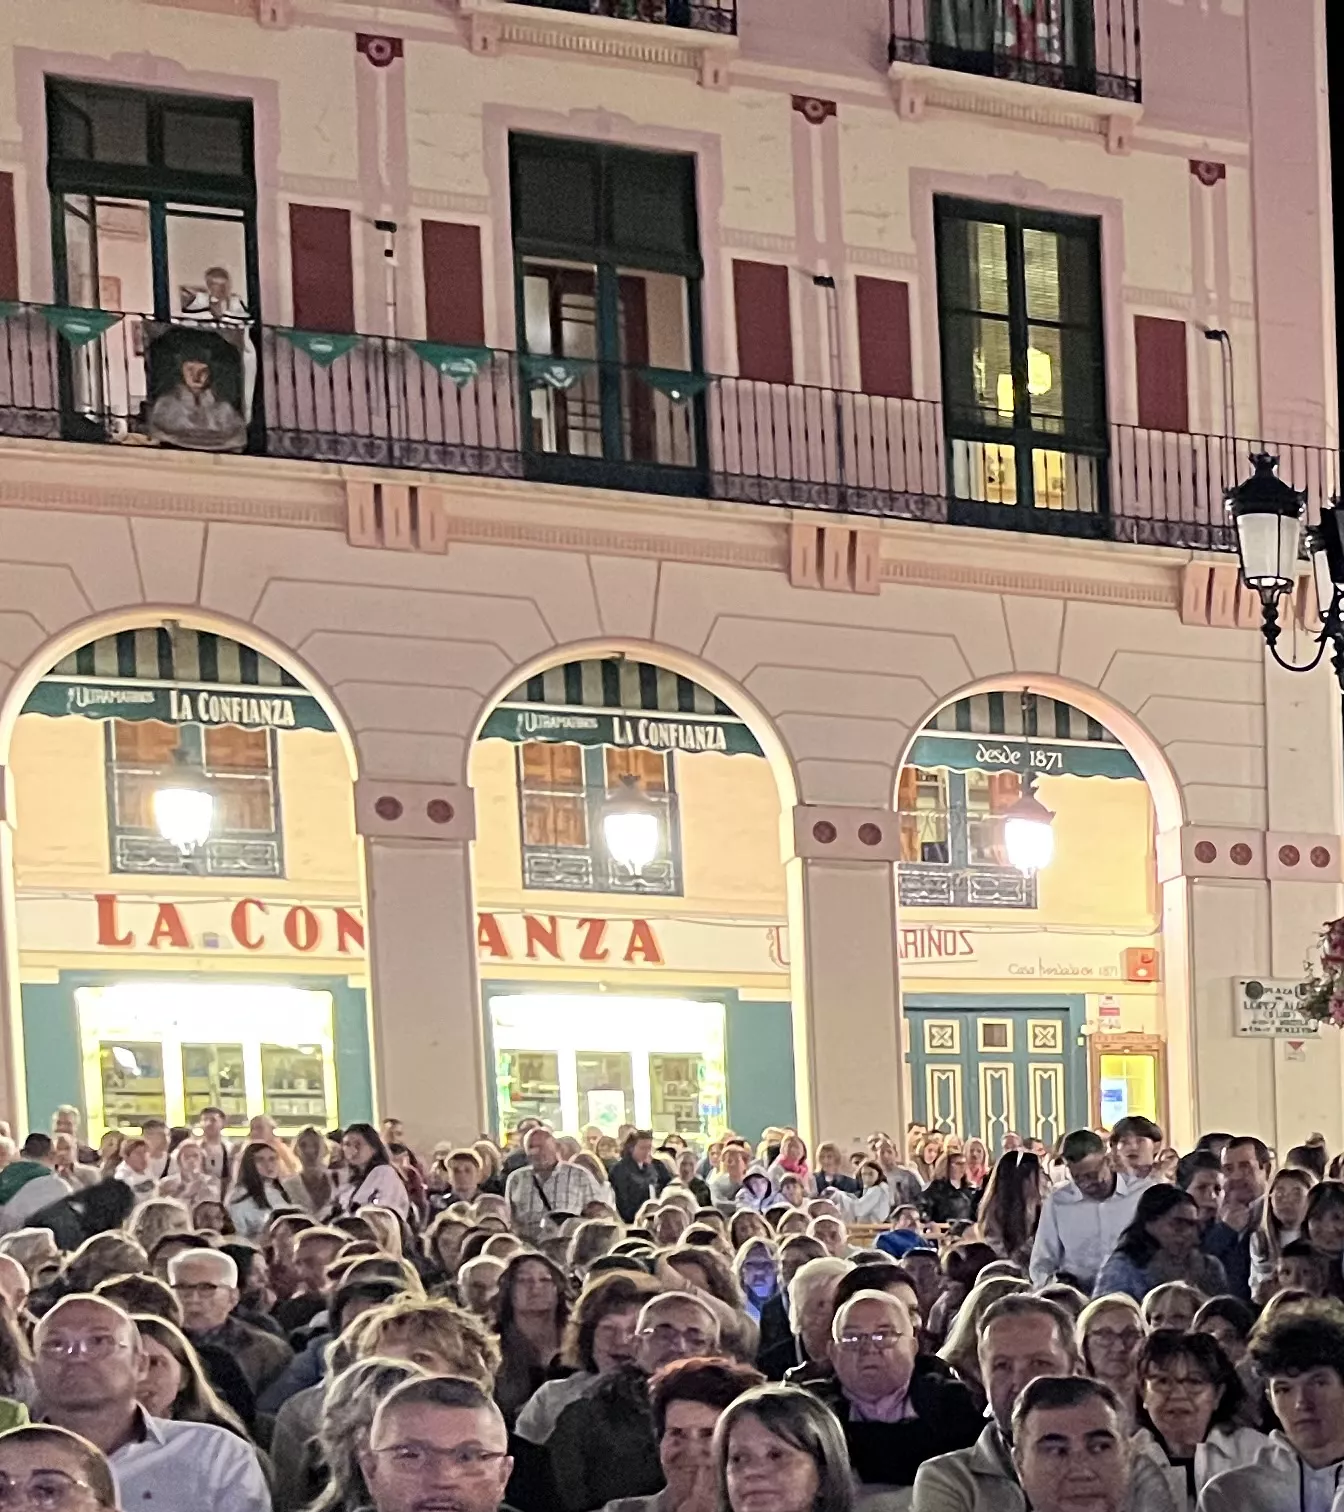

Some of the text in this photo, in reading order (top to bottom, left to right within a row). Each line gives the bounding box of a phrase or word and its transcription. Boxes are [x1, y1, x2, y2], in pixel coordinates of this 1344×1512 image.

[169, 690, 296, 726] LA CONFIANZA
[612, 717, 727, 750] LA CONFIANZA
[976, 744, 1063, 770] desde 1871
[94, 893, 193, 949] LA
